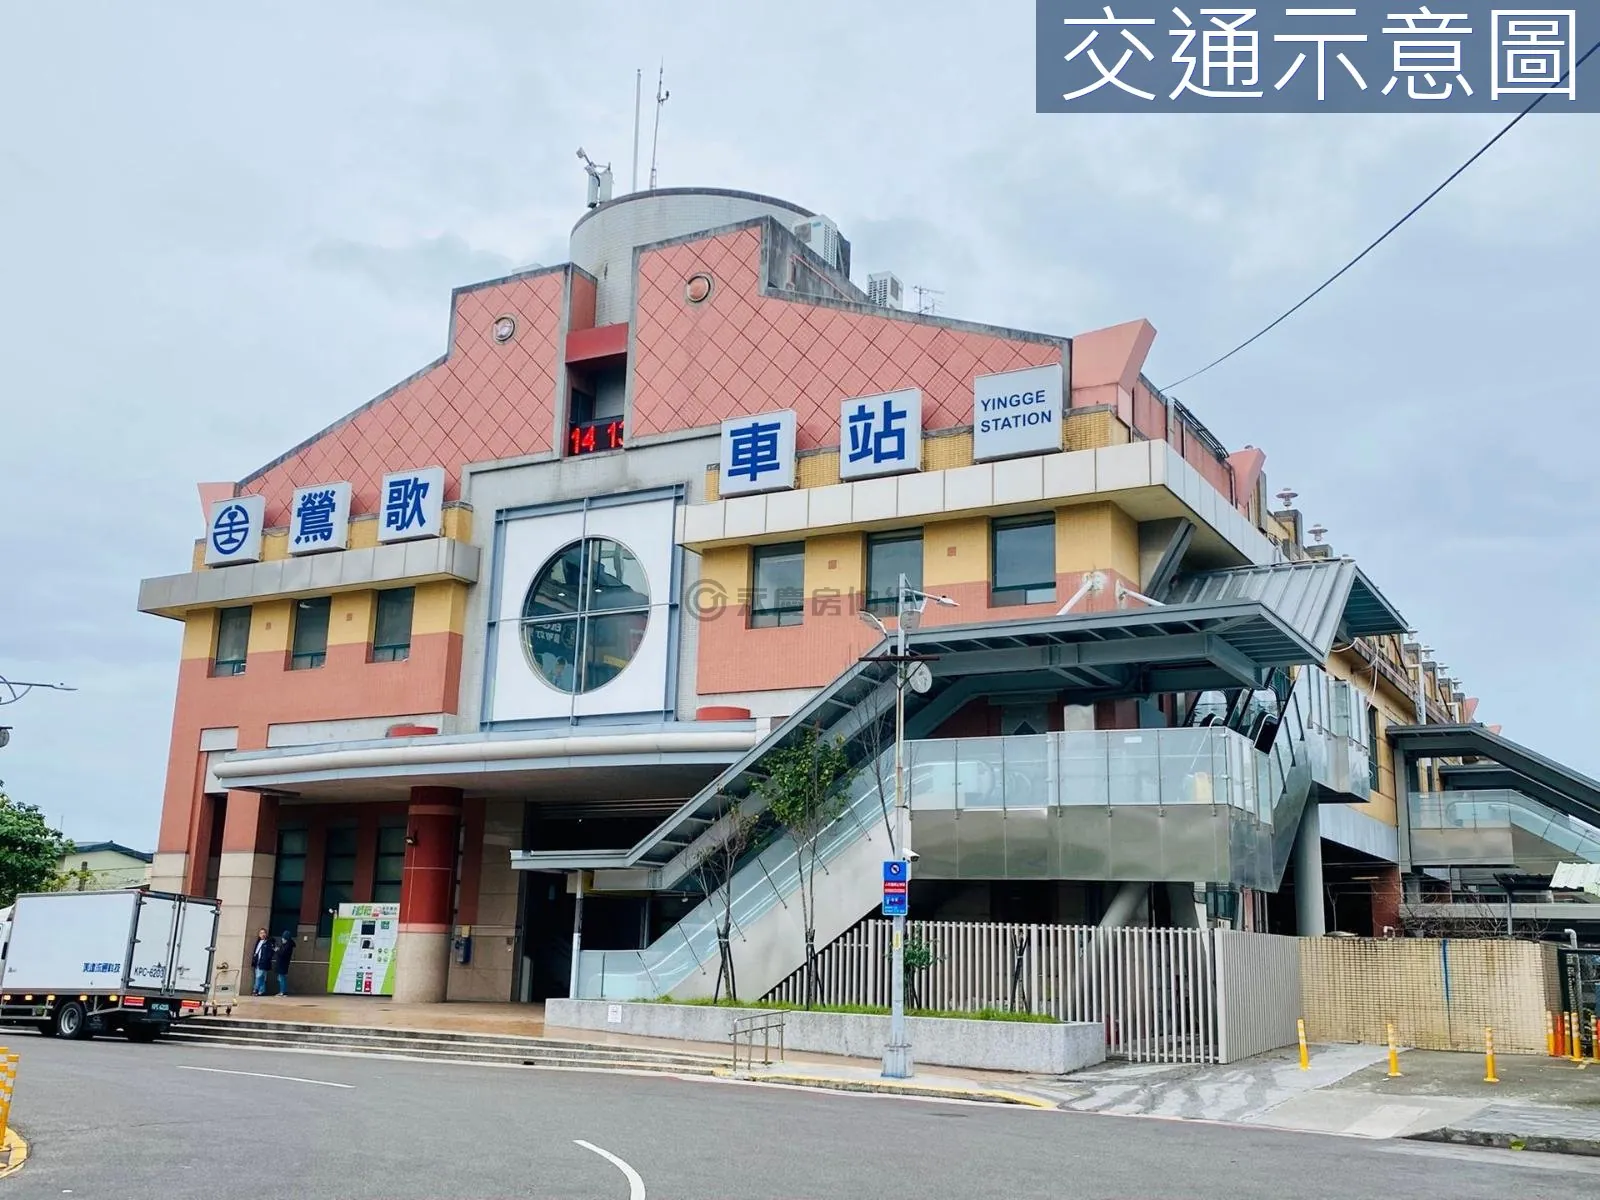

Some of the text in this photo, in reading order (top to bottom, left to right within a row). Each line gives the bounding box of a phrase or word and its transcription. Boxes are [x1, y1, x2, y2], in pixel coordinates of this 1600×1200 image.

[981, 390, 1046, 412] YINGGE
[981, 410, 1052, 433] STATION
[571, 426, 596, 454] 14
[728, 400, 907, 482] 車站
[294, 477, 430, 545] 鶯歌
